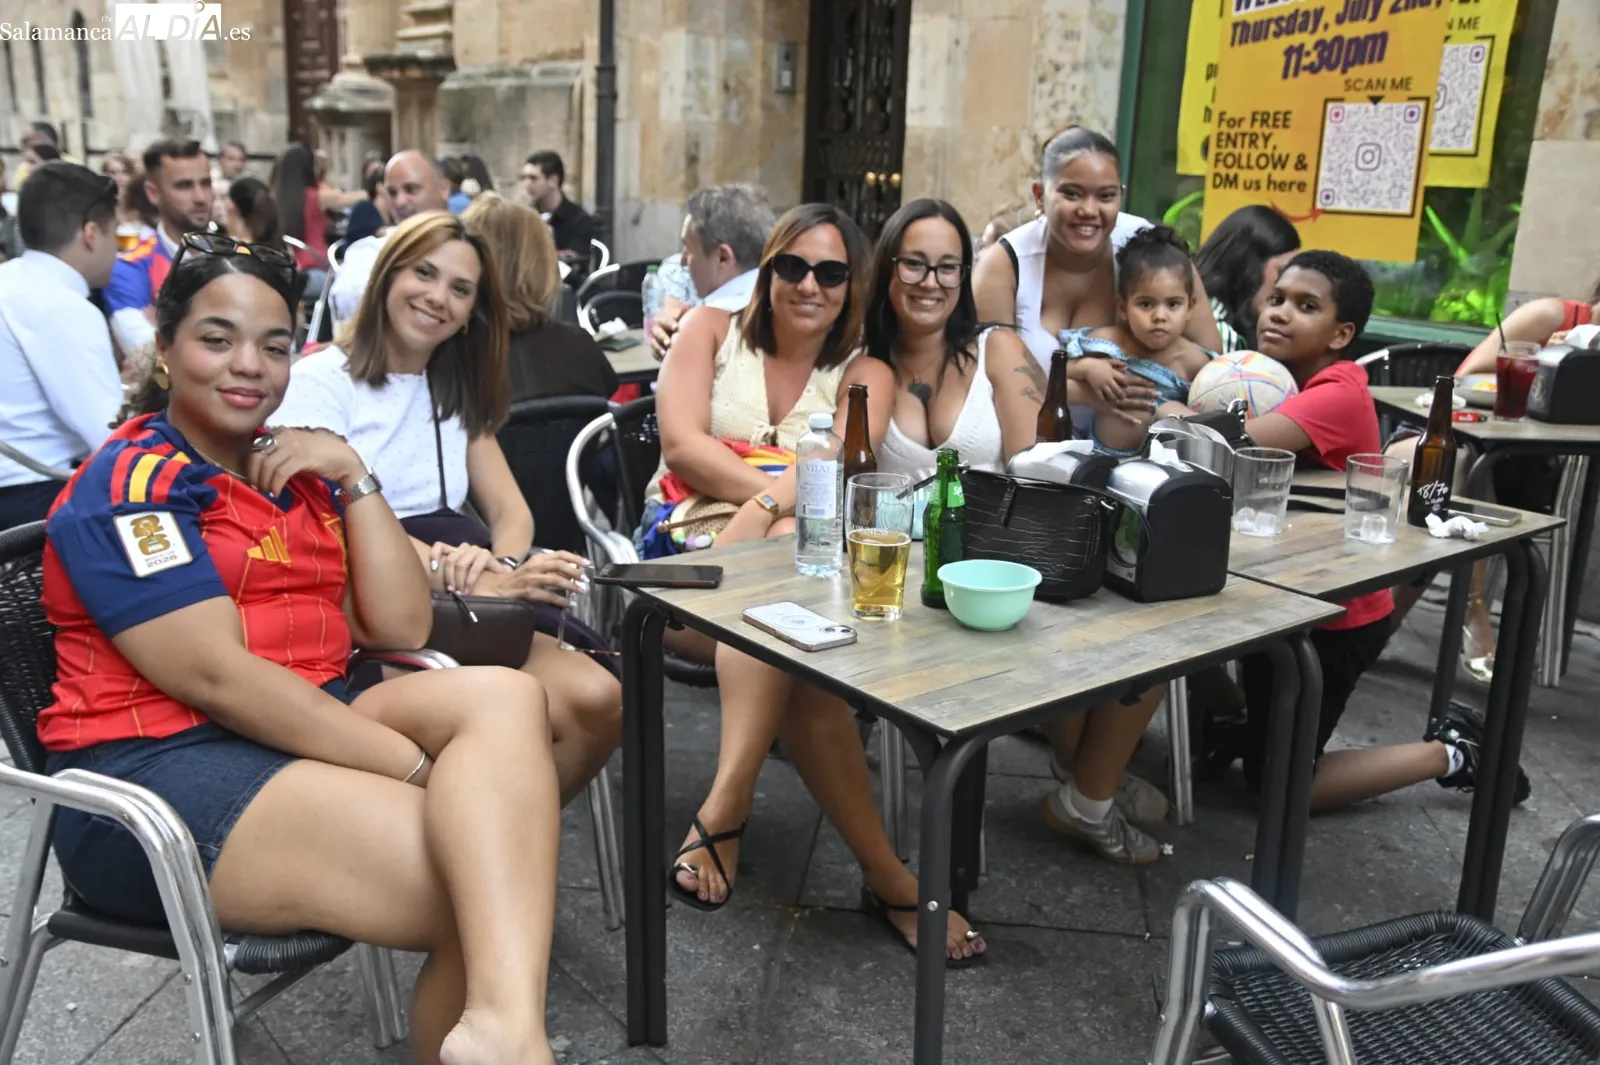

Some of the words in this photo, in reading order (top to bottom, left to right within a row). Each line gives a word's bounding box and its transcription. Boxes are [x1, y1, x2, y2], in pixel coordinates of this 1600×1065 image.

[1230, 6, 1330, 48] Thursday,
[1335, 0, 1385, 25] July
[1281, 31, 1389, 80] 11:30pm
[1343, 77, 1387, 92] SCAN
[1390, 76, 1413, 91] ME
[1217, 110, 1246, 129] For
[1250, 110, 1292, 129] FREE
[1215, 131, 1278, 151] ENTRY,
[1213, 152, 1291, 171] FOLLOW
[1294, 153, 1309, 171] &
[1212, 172, 1239, 189] DM
[1243, 179, 1261, 191] us
[1266, 174, 1308, 192] here
